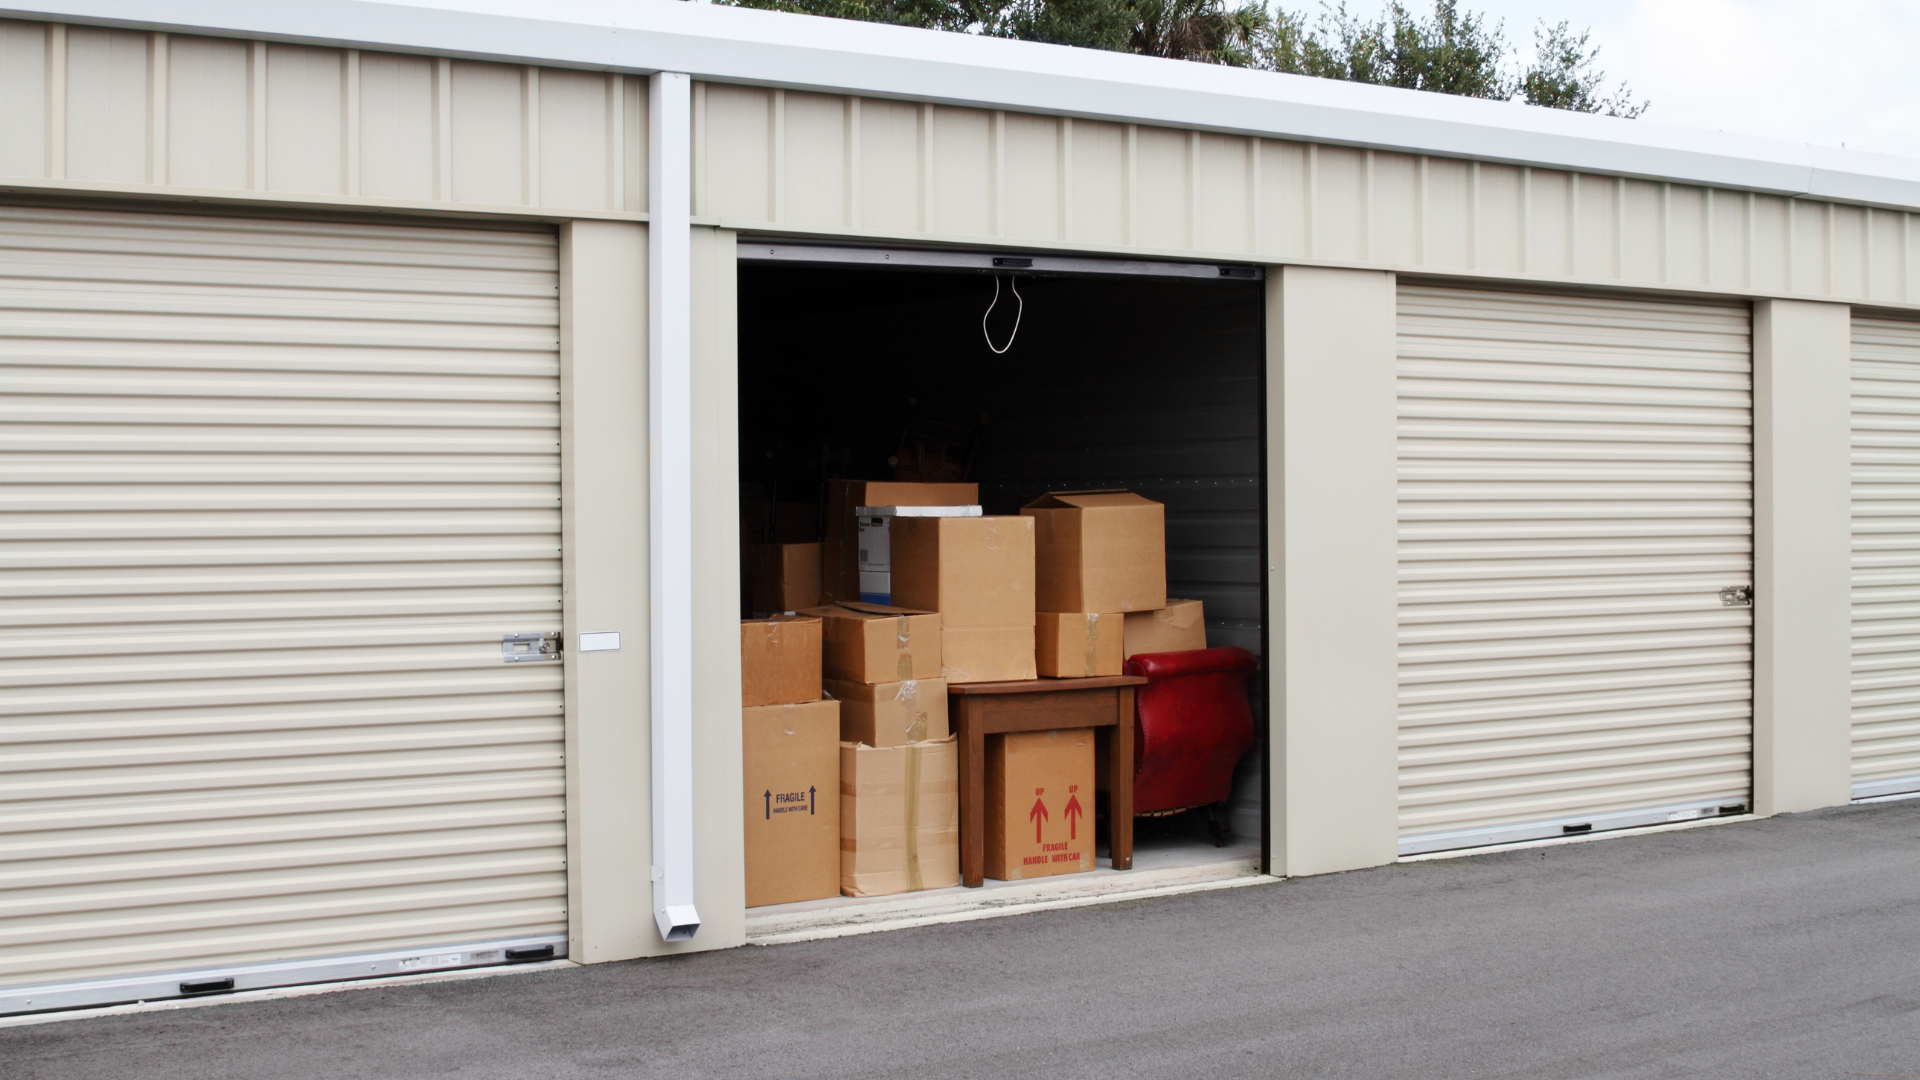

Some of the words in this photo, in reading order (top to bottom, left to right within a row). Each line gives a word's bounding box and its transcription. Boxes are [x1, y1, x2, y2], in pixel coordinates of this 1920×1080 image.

[1035, 788, 1045, 796] UP
[1069, 785, 1078, 793] UP
[776, 791, 805, 803] FRAGILE
[773, 806, 787, 814] HANDLE
[1042, 842, 1068, 852] FRAGILE
[1023, 855, 1048, 866] HANDLE
[1051, 853, 1068, 863] WITH
[1068, 852, 1083, 861] CAR
